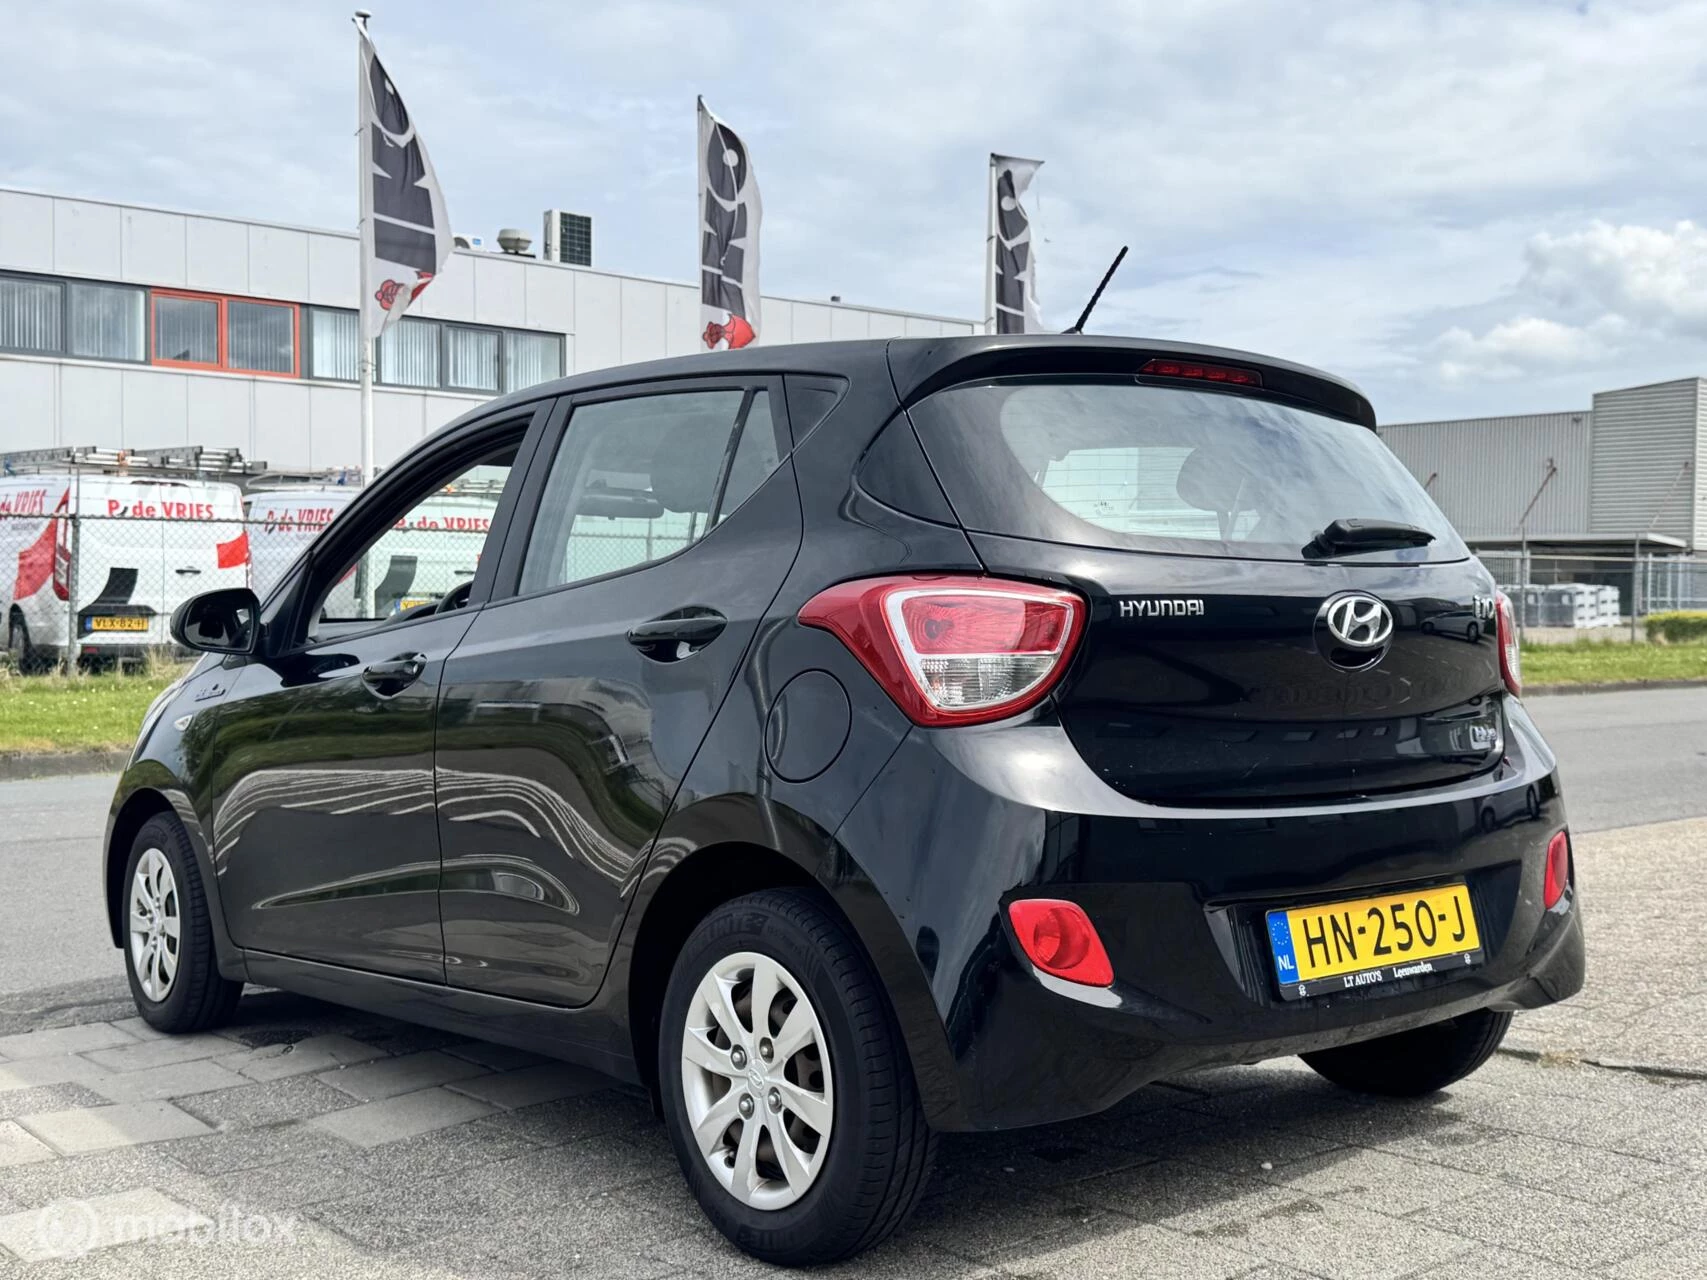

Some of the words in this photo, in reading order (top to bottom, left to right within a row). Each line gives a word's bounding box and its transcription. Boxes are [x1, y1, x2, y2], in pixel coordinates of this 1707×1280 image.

[132, 500, 156, 518] de
[161, 501, 214, 520] VRIES
[1119, 600, 1204, 617] HYUNDAI
[1473, 595, 1494, 618] i10
[1303, 896, 1465, 967] HN-250-J
[1278, 955, 1294, 970] NL
